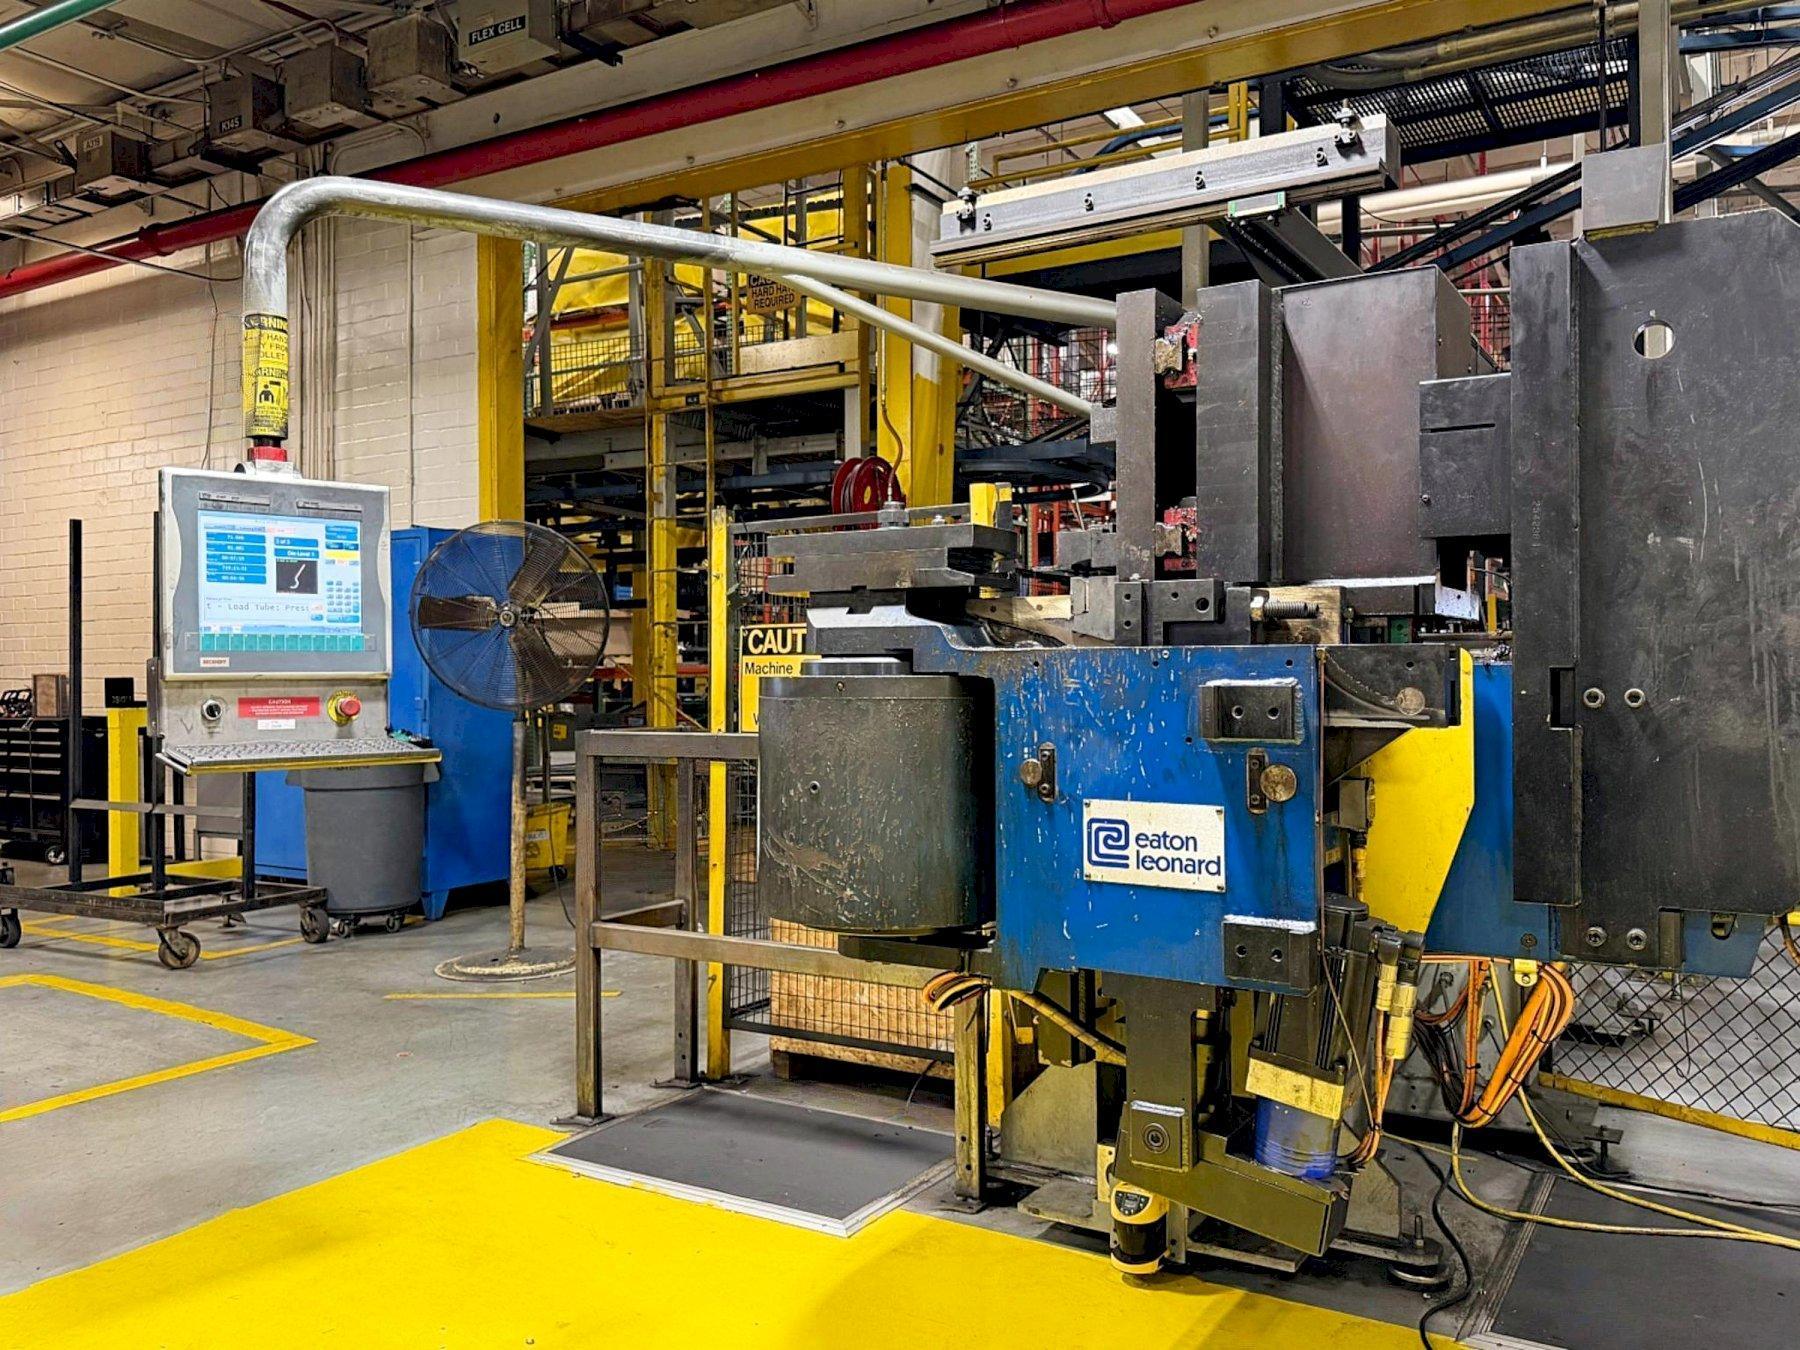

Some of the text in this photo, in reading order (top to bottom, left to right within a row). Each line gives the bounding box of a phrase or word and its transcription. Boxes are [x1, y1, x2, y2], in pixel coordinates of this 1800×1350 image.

[472, 18, 522, 43] FLEX CELL
[752, 285, 775, 298] HARD
[755, 293, 795, 309] REQUIRED
[228, 602, 250, 611] Load
[748, 629, 807, 655] CAUT
[745, 662, 793, 675] Machine
[1135, 831, 1198, 852] eaton
[1136, 850, 1221, 877] leonard
